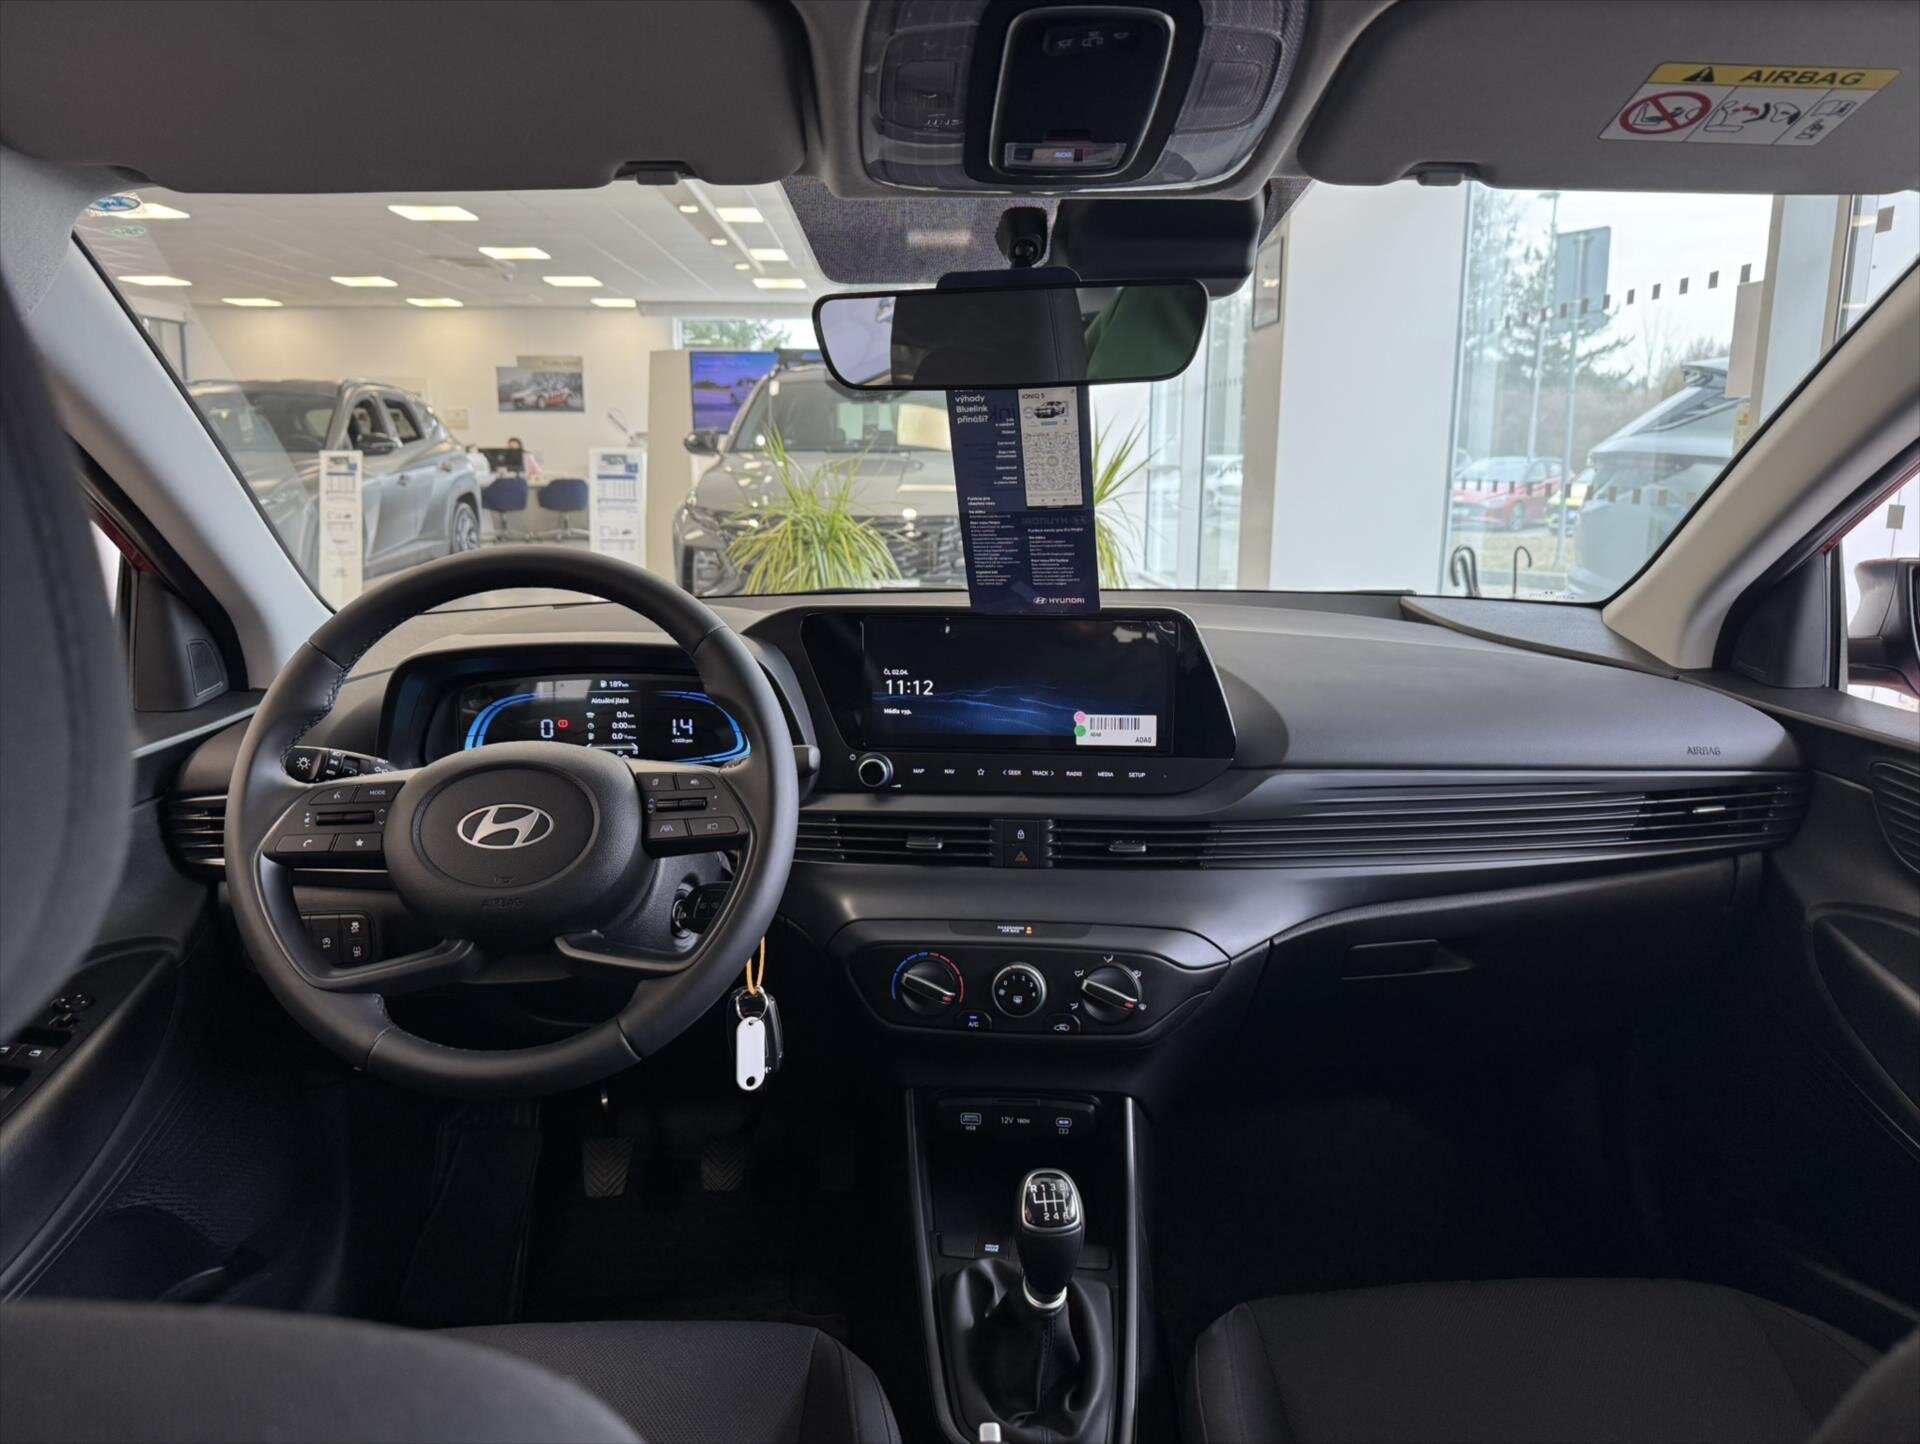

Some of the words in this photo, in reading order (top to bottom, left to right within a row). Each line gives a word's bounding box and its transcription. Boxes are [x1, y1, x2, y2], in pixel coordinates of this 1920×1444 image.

[1739, 69, 1866, 86] AIRBAG
[954, 394, 985, 404] výhody
[956, 404, 988, 413] Bluelink
[1048, 596, 1085, 604] HYUNDAI
[885, 679, 934, 696] 11:12
[540, 718, 554, 738] 0
[672, 718, 693, 736] 1.4
[1686, 746, 1721, 756] AIRBAG
[1000, 1116, 1014, 1124] 12V
[1030, 1184, 1038, 1193] R
[1040, 1184, 1046, 1192] 1
[1050, 1183, 1056, 1191] 3
[1043, 1212, 1050, 1221] 2
[1053, 1212, 1060, 1220] 4
